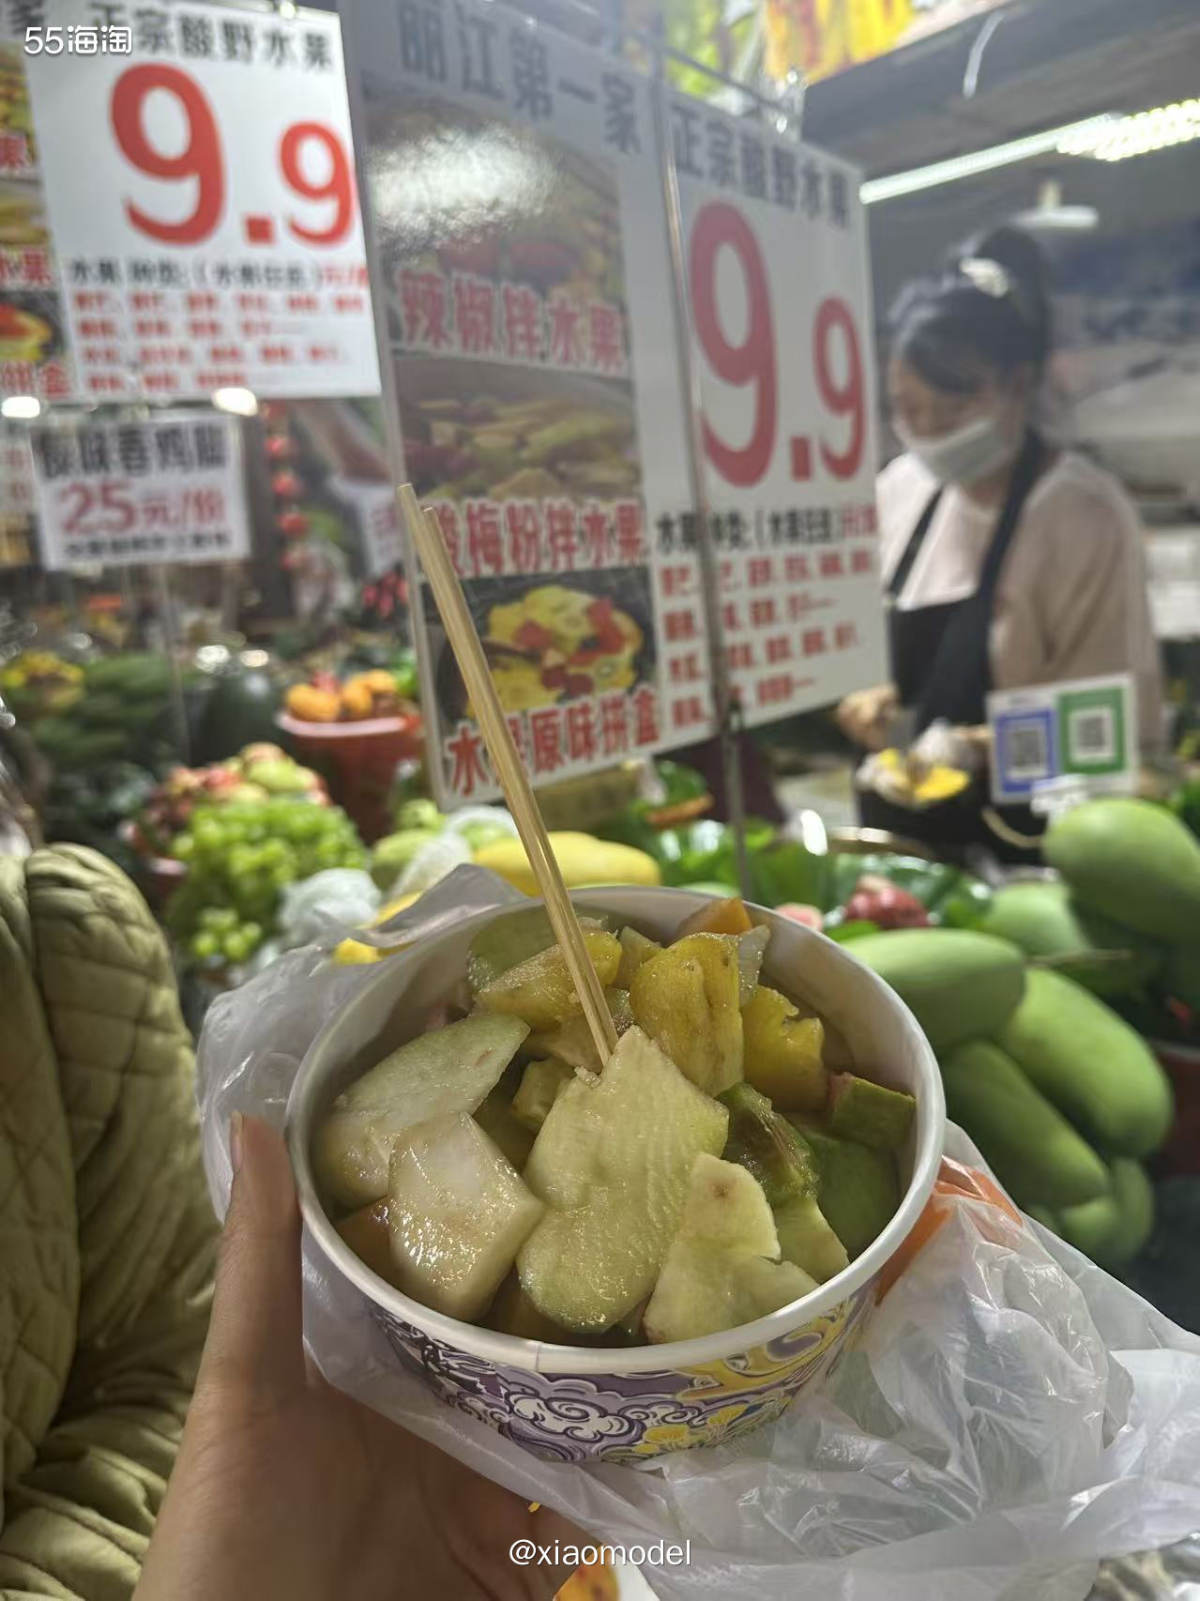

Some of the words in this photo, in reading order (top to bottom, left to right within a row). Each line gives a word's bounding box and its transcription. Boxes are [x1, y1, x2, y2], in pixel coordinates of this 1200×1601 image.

[109, 62, 355, 247] 9.9
[399, 269, 624, 371] 辣椒拌水果
[690, 199, 866, 488] 9.9
[449, 688, 658, 796] 水原味拼盒
